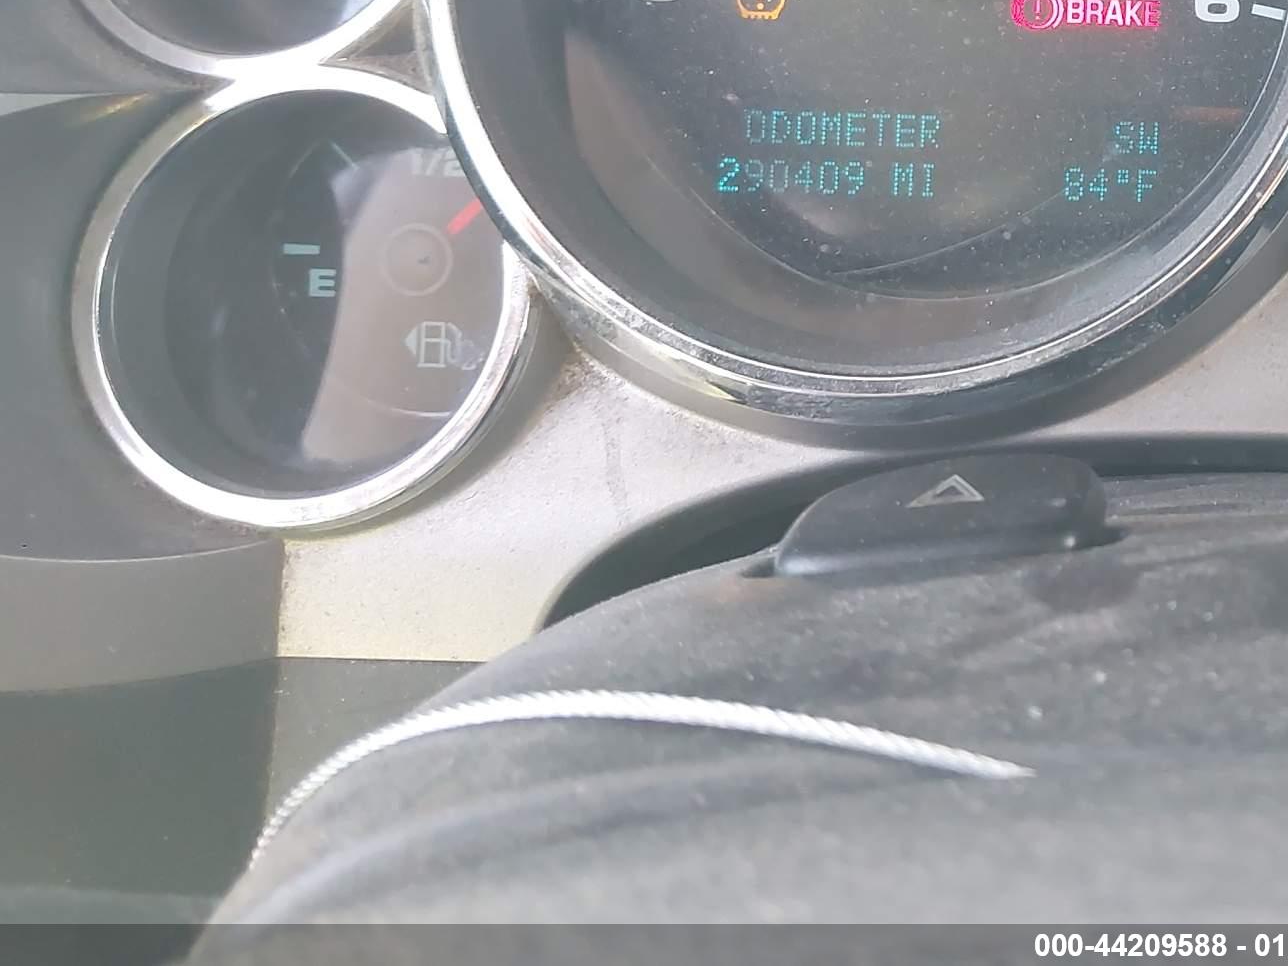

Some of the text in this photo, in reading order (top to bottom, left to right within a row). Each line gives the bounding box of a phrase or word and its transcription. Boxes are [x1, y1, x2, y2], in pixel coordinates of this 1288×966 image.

[745, 109, 941, 148] ODOMETER
[1113, 121, 1159, 154] SW
[717, 156, 937, 197] 290409 MI
[310, 269, 336, 297] E
